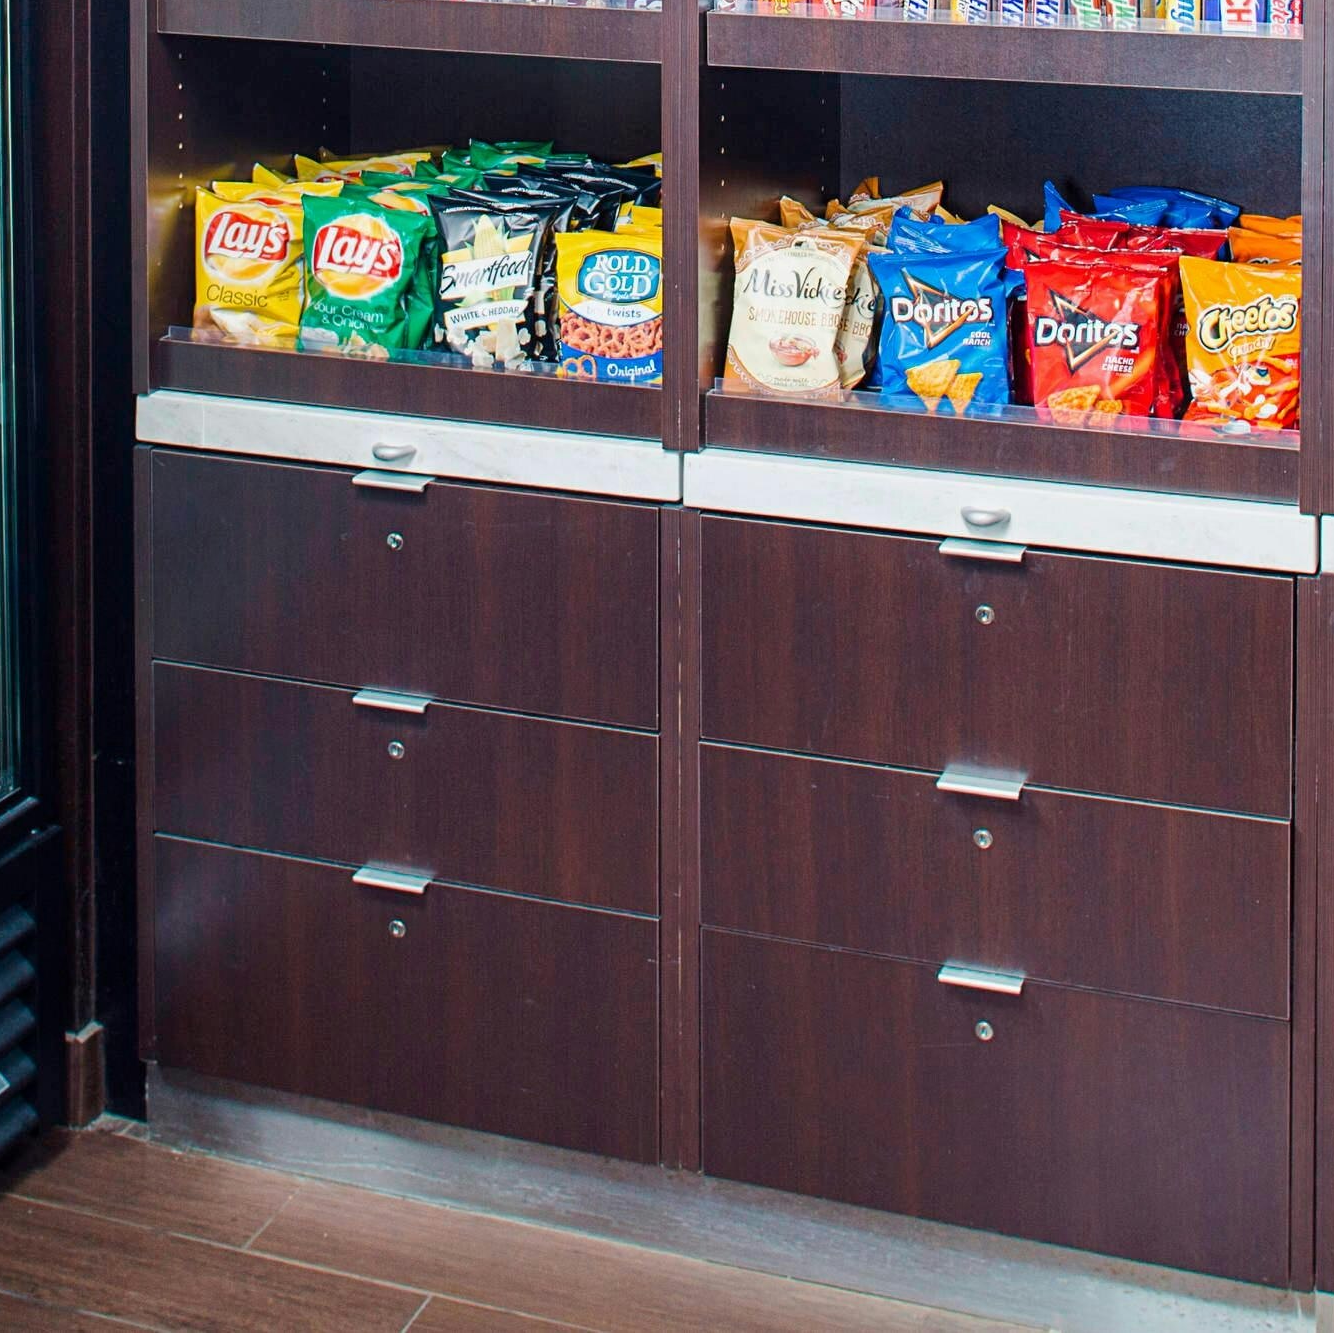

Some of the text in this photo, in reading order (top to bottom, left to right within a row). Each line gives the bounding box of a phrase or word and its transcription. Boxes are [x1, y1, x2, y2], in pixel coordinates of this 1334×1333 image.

[208, 212, 287, 260] Lay's
[316, 226, 400, 275] Lay's
[440, 251, 531, 294] Smartfood
[594, 254, 651, 275] ROLD
[583, 272, 652, 296] GOLD
[743, 268, 794, 298] Miss
[206, 283, 269, 308] Classic
[322, 316, 331, 325] &
[341, 305, 384, 324] Cream
[450, 305, 520, 325] WHITE CHEDDAR
[606, 307, 643, 319] twists
[891, 297, 994, 323] Doritos
[1036, 317, 1140, 347] Doritos
[1198, 296, 1297, 351] Cheetos
[962, 338, 992, 347] RANCH
[970, 331, 992, 340] COOL
[606, 359, 657, 382] Original
[1101, 364, 1134, 374] CHEESE
[1104, 355, 1135, 366] NACHO
